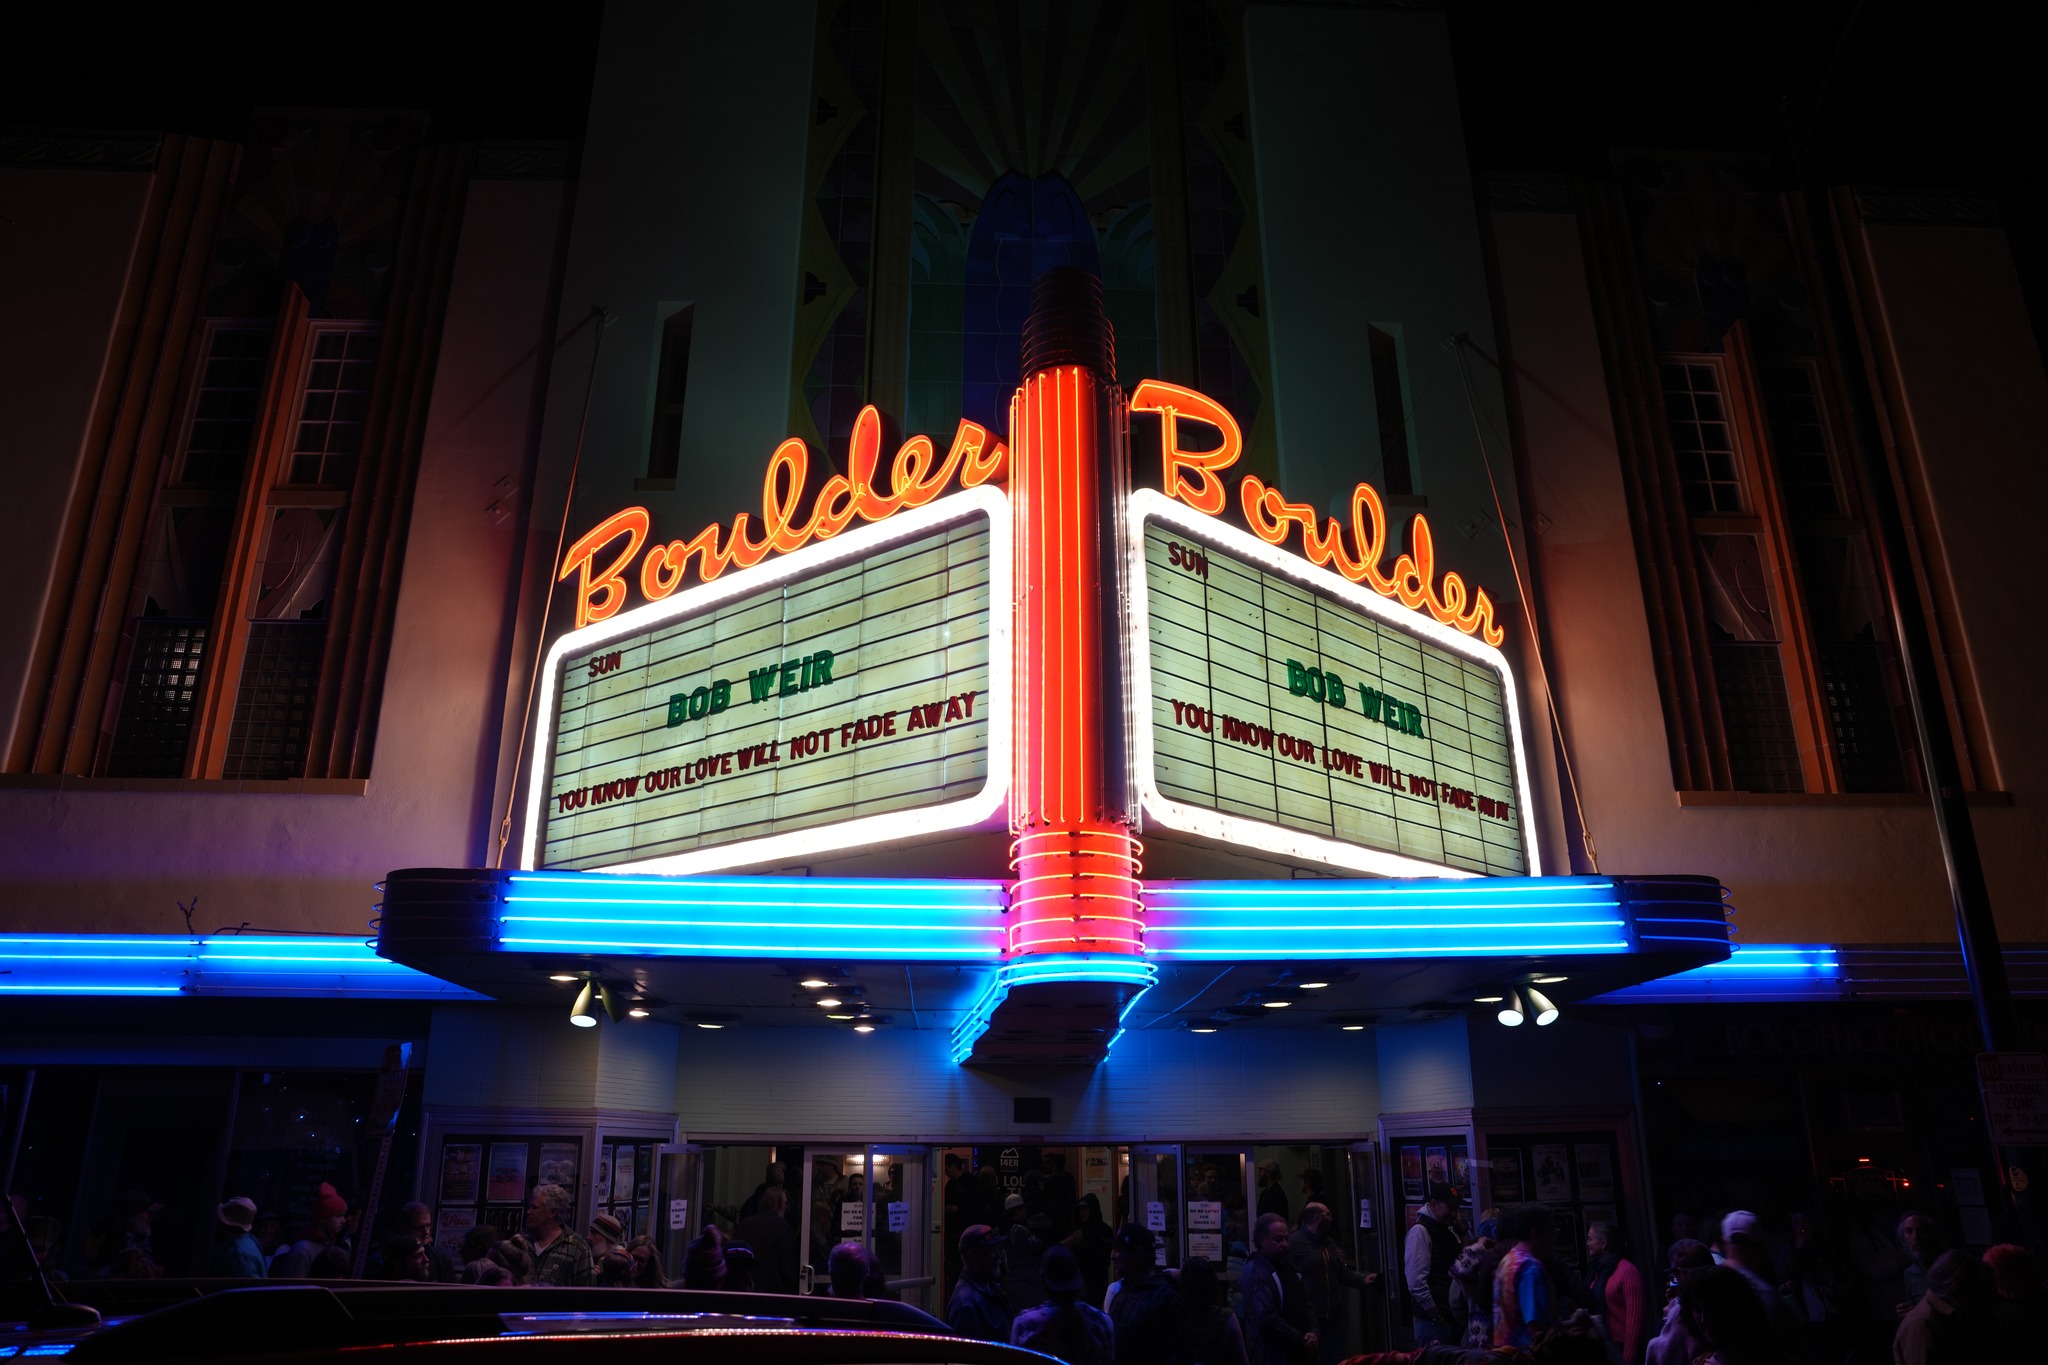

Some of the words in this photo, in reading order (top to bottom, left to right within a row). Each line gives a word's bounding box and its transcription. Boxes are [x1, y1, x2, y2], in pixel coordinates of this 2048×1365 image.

[558, 404, 1005, 629] Boulder
[1130, 378, 1503, 647] Boulder
[1168, 541, 1208, 579] SUN
[588, 650, 622, 677] SUN
[667, 678, 732, 728] BOB
[748, 649, 835, 704] WEIR
[1287, 658, 1346, 709] BOB
[1358, 682, 1425, 739] WEIR
[558, 787, 588, 813] YOU
[591, 775, 640, 805] KNOW
[644, 766, 681, 793] OUR
[685, 752, 732, 784] LOVE
[737, 740, 780, 771] WILL
[790, 728, 835, 760] NOT
[841, 711, 897, 748] FADE
[907, 691, 978, 732] AWAY
[1170, 698, 1213, 734] YOU
[1222, 714, 1274, 751] KNOW
[1277, 732, 1316, 764] OUR
[1322, 746, 1364, 779] LOVE
[1369, 761, 1406, 792] WILL
[1409, 774, 1438, 801] NOT
[1441, 782, 1476, 812] FADE
[1724, 1024, 1786, 1056] BOX
[1981, 1060, 2000, 1079] NO
[2001, 1062, 2045, 1075] PARKING
[1993, 1083, 2044, 1095] LOADING
[2005, 1098, 2038, 1110] ZONE
[1000, 1158, 1019, 1168] 14ER
